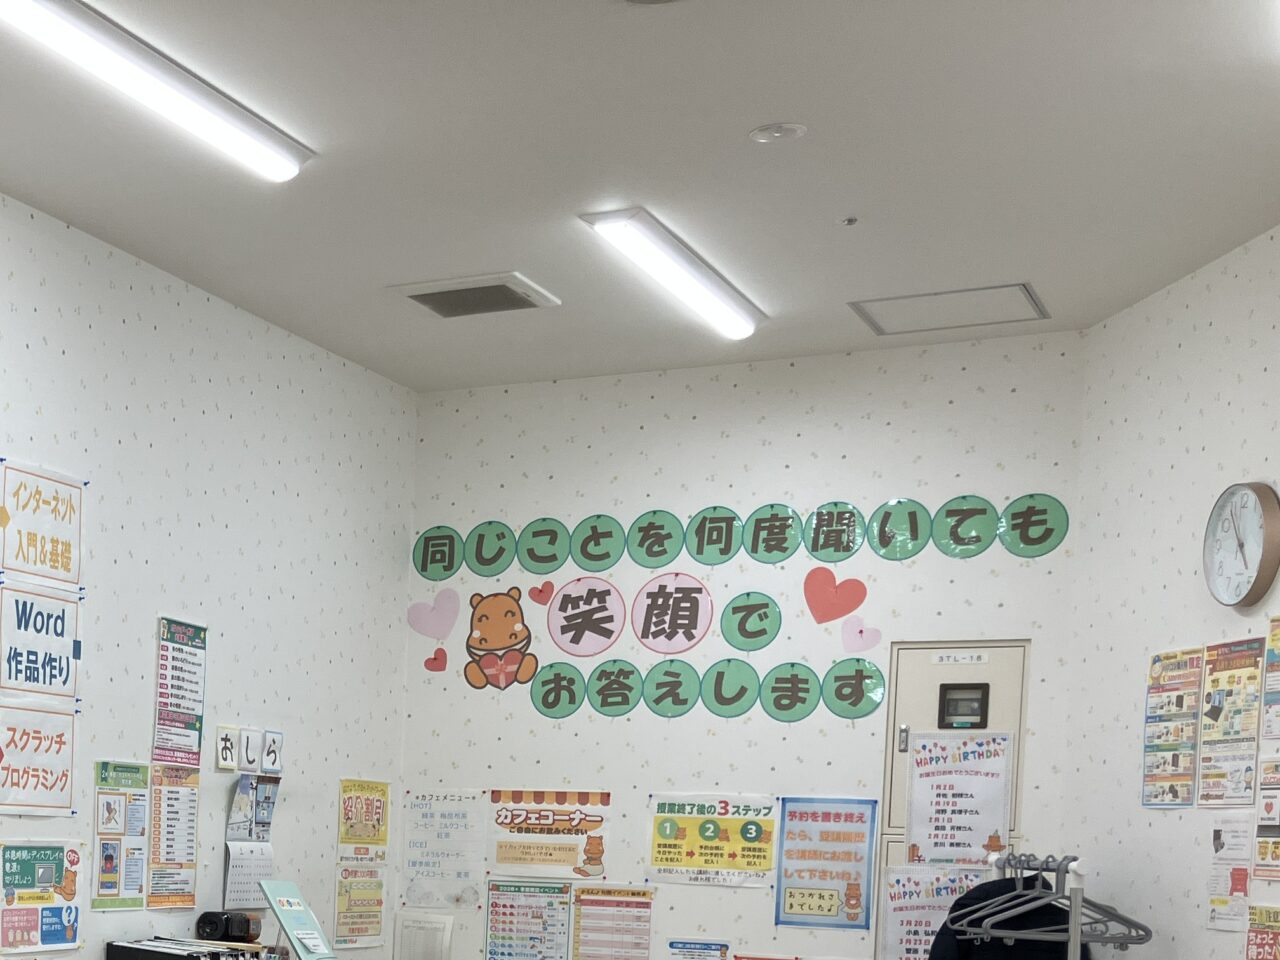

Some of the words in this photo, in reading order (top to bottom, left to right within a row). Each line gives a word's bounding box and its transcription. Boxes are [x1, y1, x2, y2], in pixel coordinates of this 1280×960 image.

[12, 480, 76, 524] インターネット
[420, 506, 1055, 572] 同じことを何度聞いても
[15, 529, 72, 574] 入門&基礎
[14, 599, 66, 638] Word
[558, 584, 770, 645] 笑顔で
[7, 646, 70, 687] 作品作り
[540, 667, 874, 712] お答えします
[6, 727, 66, 754] スクラッチ
[916, 755, 948, 768] HAPPY
[952, 748, 1005, 763] BIRTHDAY
[1, 764, 69, 792] プログラミング
[496, 807, 603, 827] カフェコーナー
[657, 800, 773, 816] 授業終了後の3ステップ
[787, 811, 866, 823] 予約を書き終え
[509, 827, 587, 835] ご自由にお飲みください
[664, 823, 671, 834] 1
[705, 824, 714, 836] 2
[747, 826, 756, 837] 3
[889, 889, 921, 902] HAPPY
